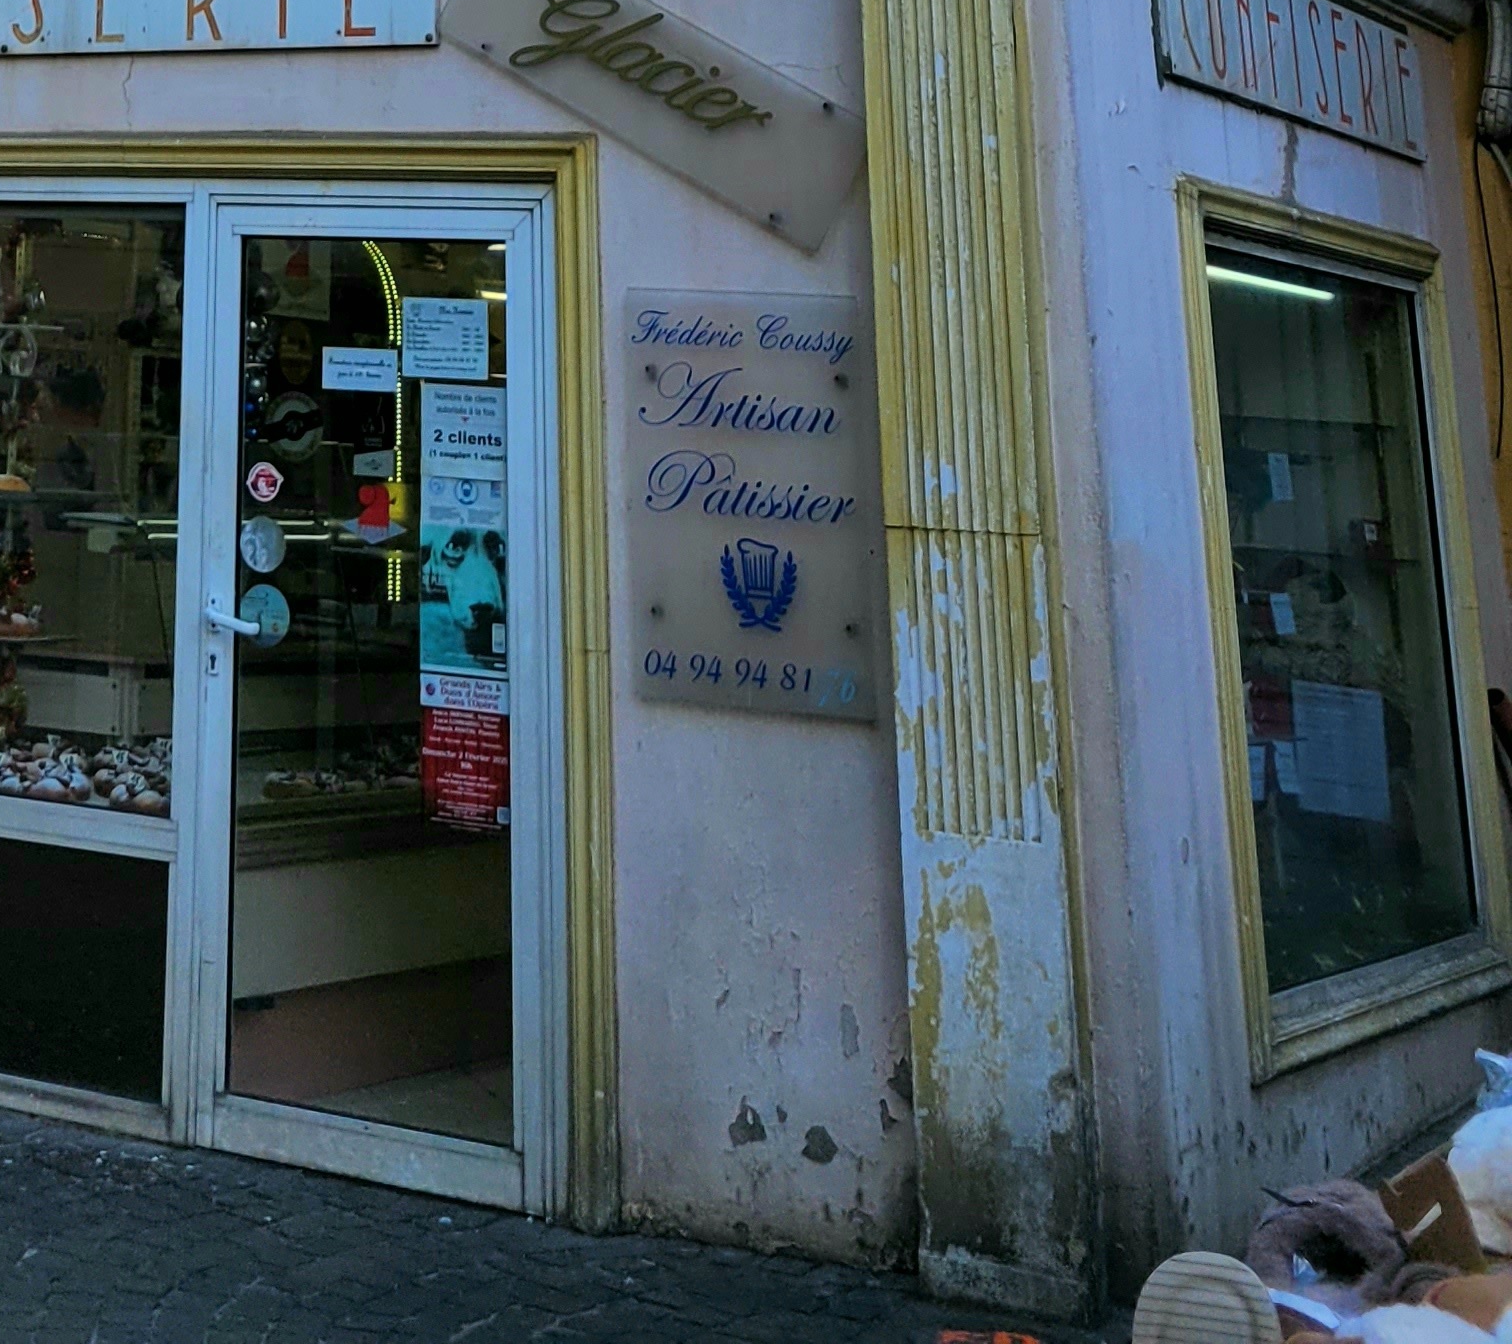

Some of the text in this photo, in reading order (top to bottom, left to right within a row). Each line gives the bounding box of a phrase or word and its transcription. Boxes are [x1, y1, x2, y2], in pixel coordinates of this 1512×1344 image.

[631, 309, 854, 364] Frédéric Coussy
[638, 361, 841, 434] Artisan
[433, 428, 503, 447] 2 clients
[645, 450, 856, 523] Pâtissier
[643, 649, 677, 681] 04
[689, 654, 722, 685] 94
[734, 658, 767, 689] 94
[779, 663, 812, 693] 81
